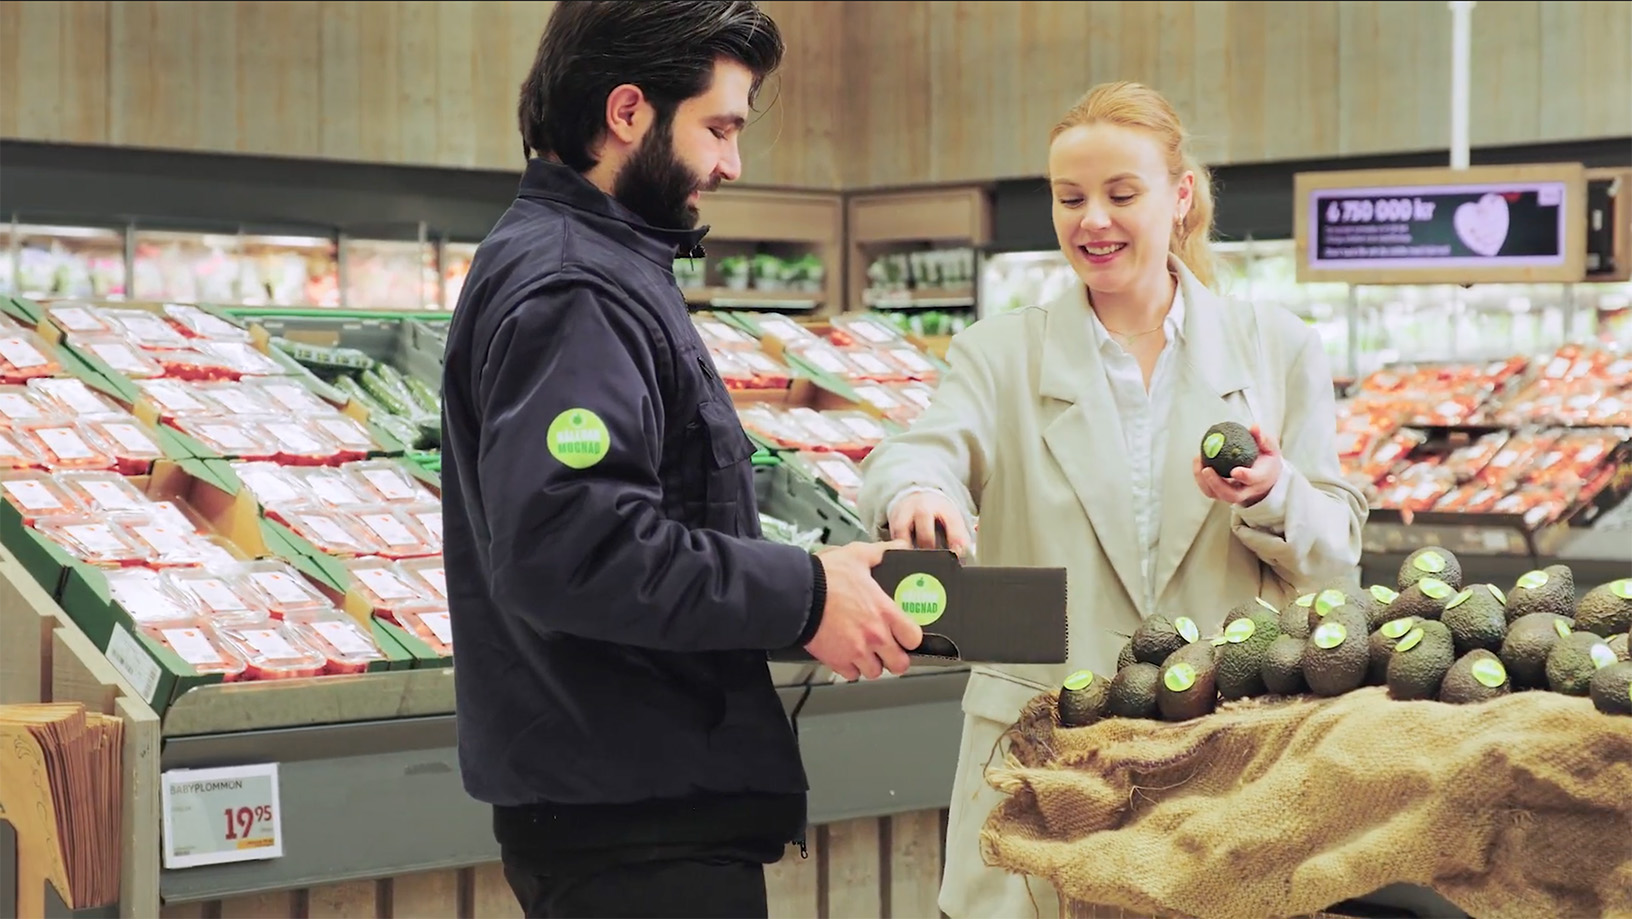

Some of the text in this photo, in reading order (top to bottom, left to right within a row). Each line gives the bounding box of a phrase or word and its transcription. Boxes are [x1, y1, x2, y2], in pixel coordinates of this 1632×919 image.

[1326, 201, 1340, 223] 6
[1375, 198, 1413, 222] 000
[1413, 197, 1436, 221] kr
[558, 442, 601, 454] MOGNAD
[902, 602, 938, 613] MOGNAD
[170, 780, 243, 796] BABYPLOMMON
